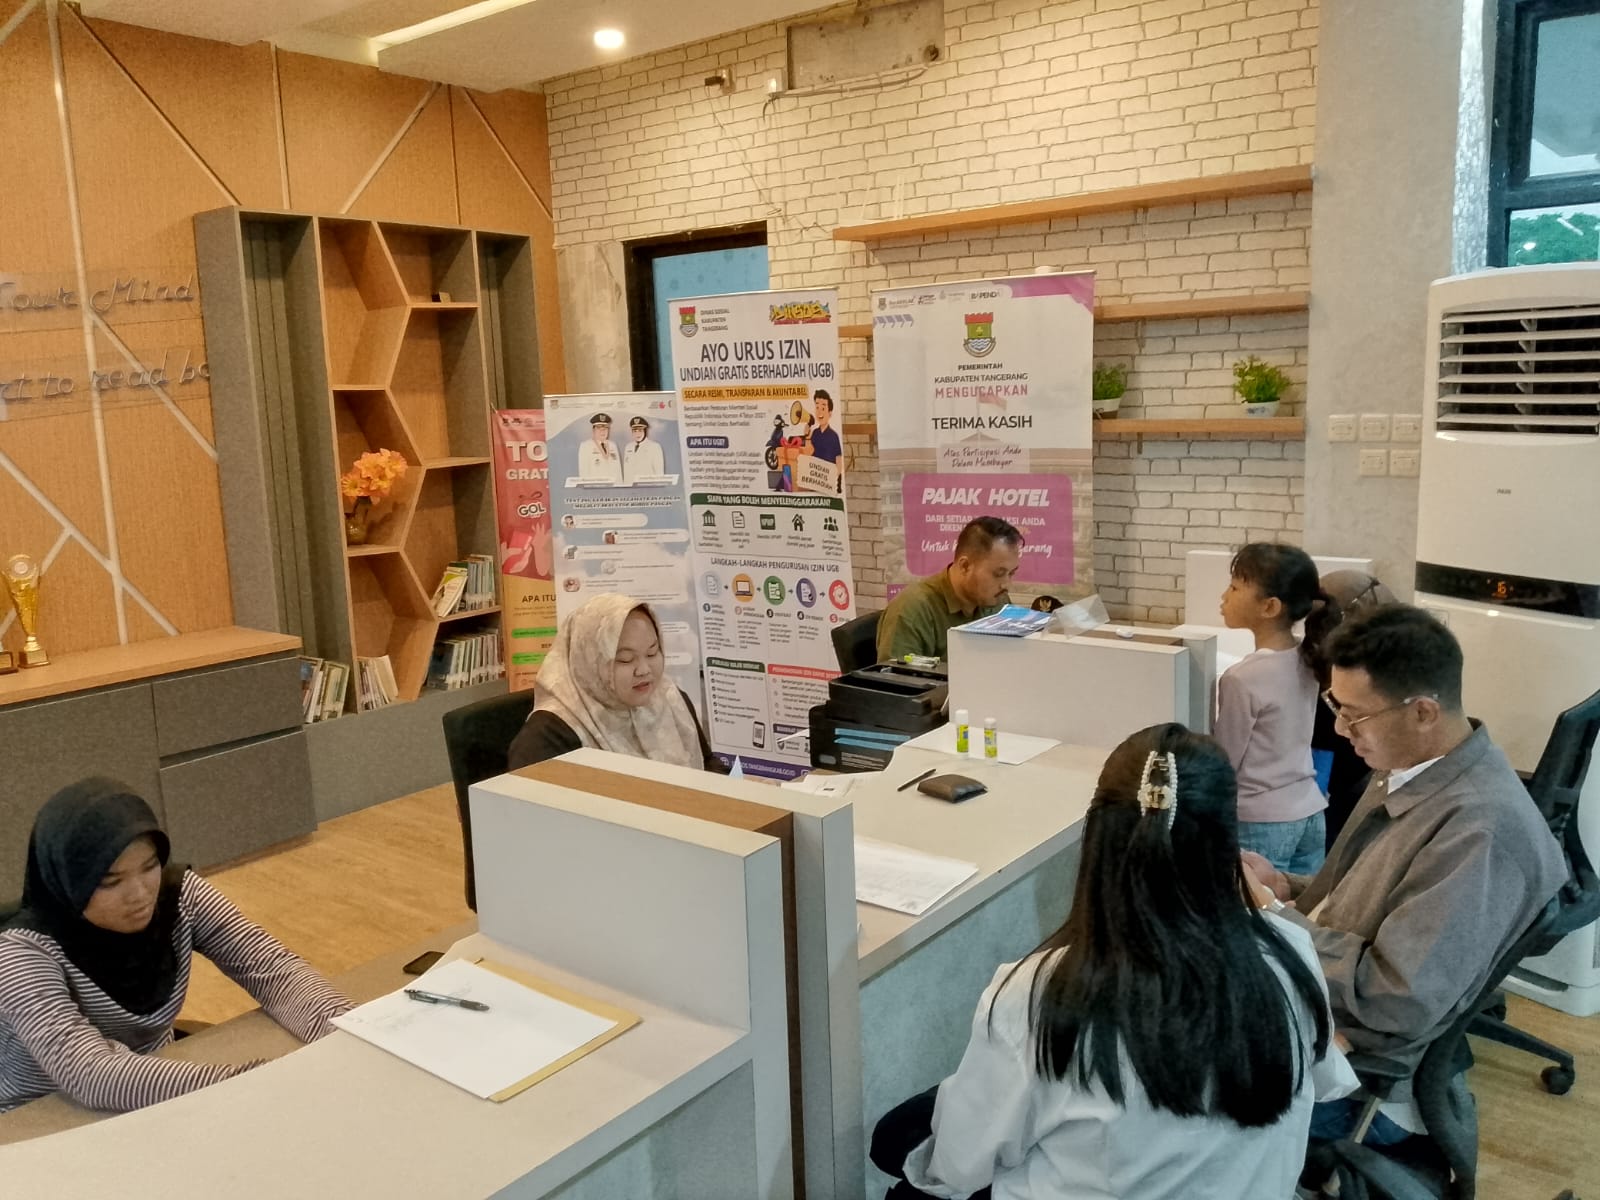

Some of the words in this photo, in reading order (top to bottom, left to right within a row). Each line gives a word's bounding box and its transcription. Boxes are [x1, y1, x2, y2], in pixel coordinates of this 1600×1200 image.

[89, 273, 194, 312] Mind
[701, 343, 728, 362] AYO
[734, 340, 774, 361] URUS
[780, 339, 811, 360] IZIN
[680, 367, 716, 382] UNDIAN
[719, 365, 748, 380] GRATIS
[752, 364, 806, 379] BERHADIAH
[808, 362, 834, 380] (UGB)
[958, 363, 1002, 371] PEMERINTAH
[39, 372, 74, 398] to
[90, 350, 168, 391] read
[934, 375, 979, 384] KABUPATEN
[981, 373, 1028, 382] TANGERANG
[684, 390, 706, 398] SECARA
[726, 388, 765, 398] TRANSPARAN
[766, 388, 771, 396] &
[772, 387, 807, 396] AKUNTABEL
[935, 384, 1028, 398] MENGUCAPKAN
[932, 416, 986, 430] TERIMA
[989, 415, 1032, 428] KASIH
[690, 438, 702, 446] APA
[702, 438, 712, 446] ITU
[944, 447, 960, 458] Atas
[962, 445, 1000, 457] Partisipasi
[1002, 445, 1022, 456] Anda
[952, 458, 974, 467] Dalam
[975, 458, 1012, 468] Membayar
[810, 470, 828, 481] GRATIS
[802, 476, 834, 490] BERHADIAH
[708, 495, 722, 504] SIAPA
[722, 496, 740, 504] YANG
[742, 496, 760, 505] BOLEH
[922, 488, 982, 505] PAJAK
[988, 488, 1050, 506] HOTEL
[926, 514, 944, 523] DARI
[946, 514, 972, 523] SETIAP
[1022, 518, 1045, 526] ANDA
[922, 540, 950, 552] Untuk
[1018, 544, 1052, 558] gerang
[711, 557, 768, 568] LANGKAH-LANGKAH
[768, 562, 809, 572] PENGURUSAN
[810, 564, 824, 572] IZIN
[826, 564, 840, 572] UGB
[522, 595, 540, 603] APA
[542, 594, 556, 602] ITU
